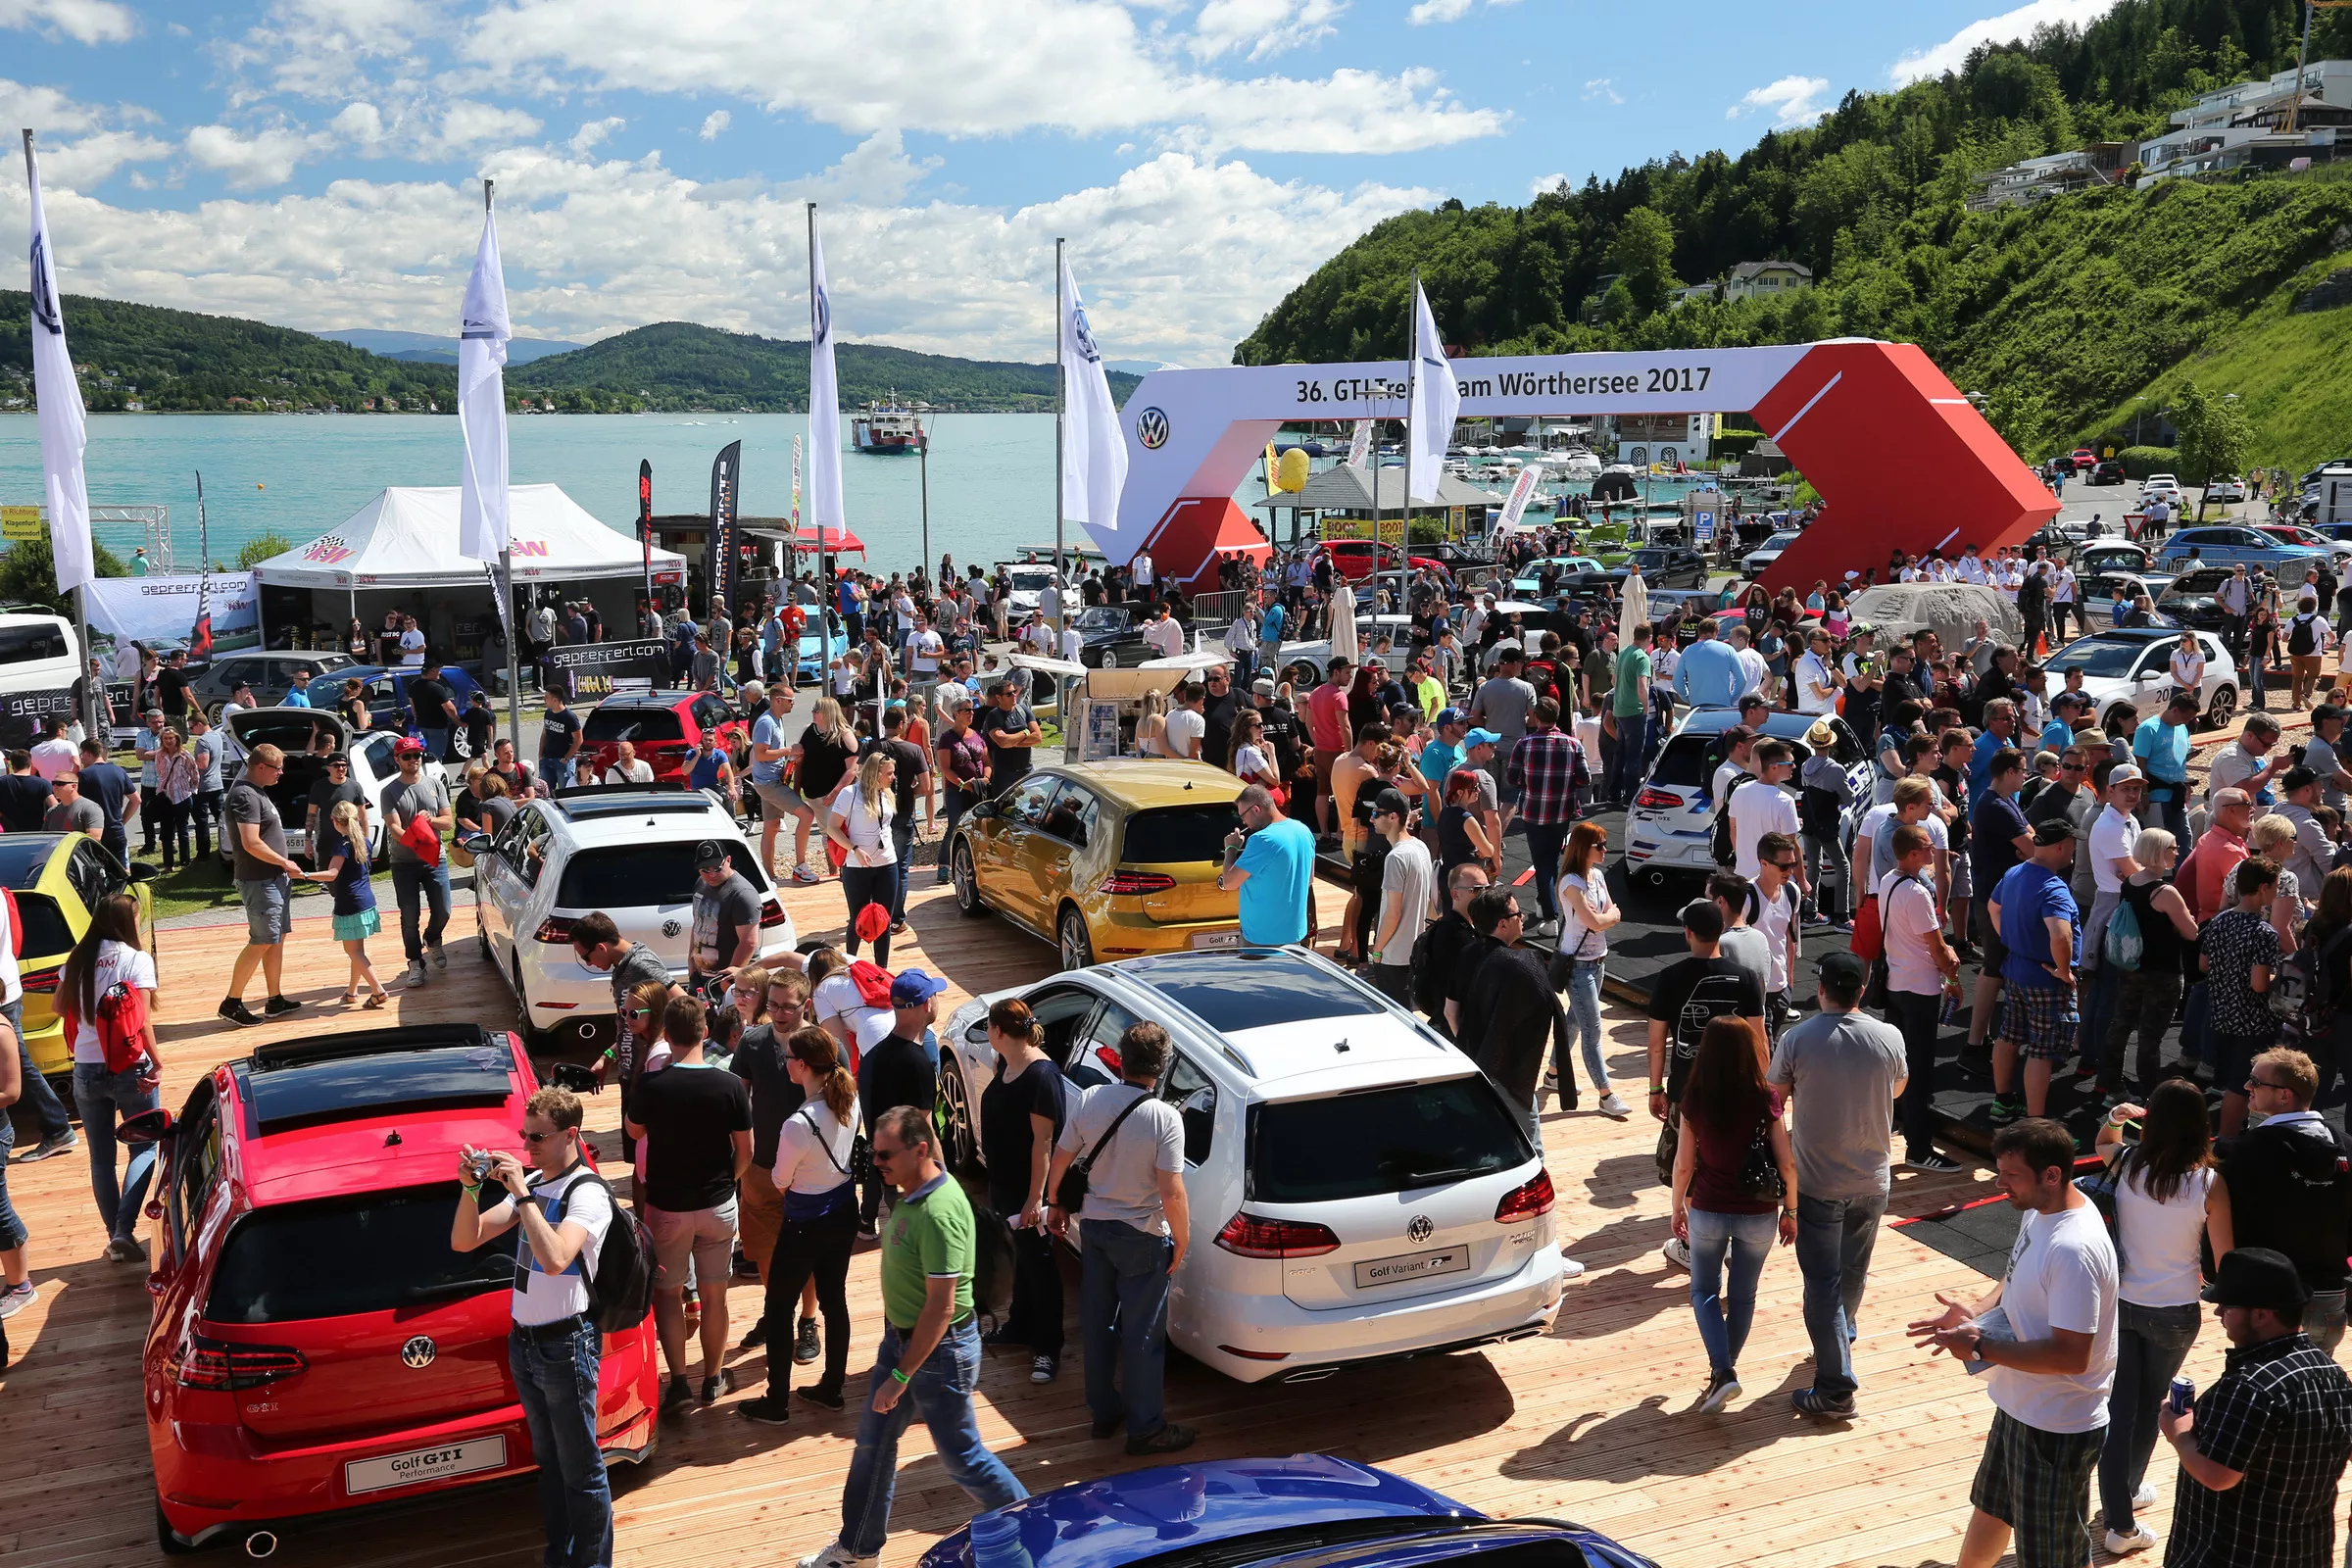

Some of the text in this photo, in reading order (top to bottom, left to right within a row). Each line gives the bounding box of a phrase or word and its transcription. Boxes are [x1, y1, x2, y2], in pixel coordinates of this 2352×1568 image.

[1297, 380, 1328, 403] 36.
[1334, 378, 1369, 402] GTI
[1457, 379, 1492, 398] am
[1498, 370, 1640, 396] Wörthersee
[1646, 367, 1711, 393] 2017
[1699, 513, 1711, 525] P
[141, 580, 248, 596] gepfeffrt.com
[553, 645, 664, 668] gepfeffert.com
[1288, 1267, 1318, 1276] GOLF
[1369, 1265, 1391, 1278] Golf
[1392, 1260, 1425, 1274] Variant
[246, 1401, 279, 1413] GTI
[391, 1448, 463, 1472] Golf GTI
[399, 1462, 456, 1480] Performance
